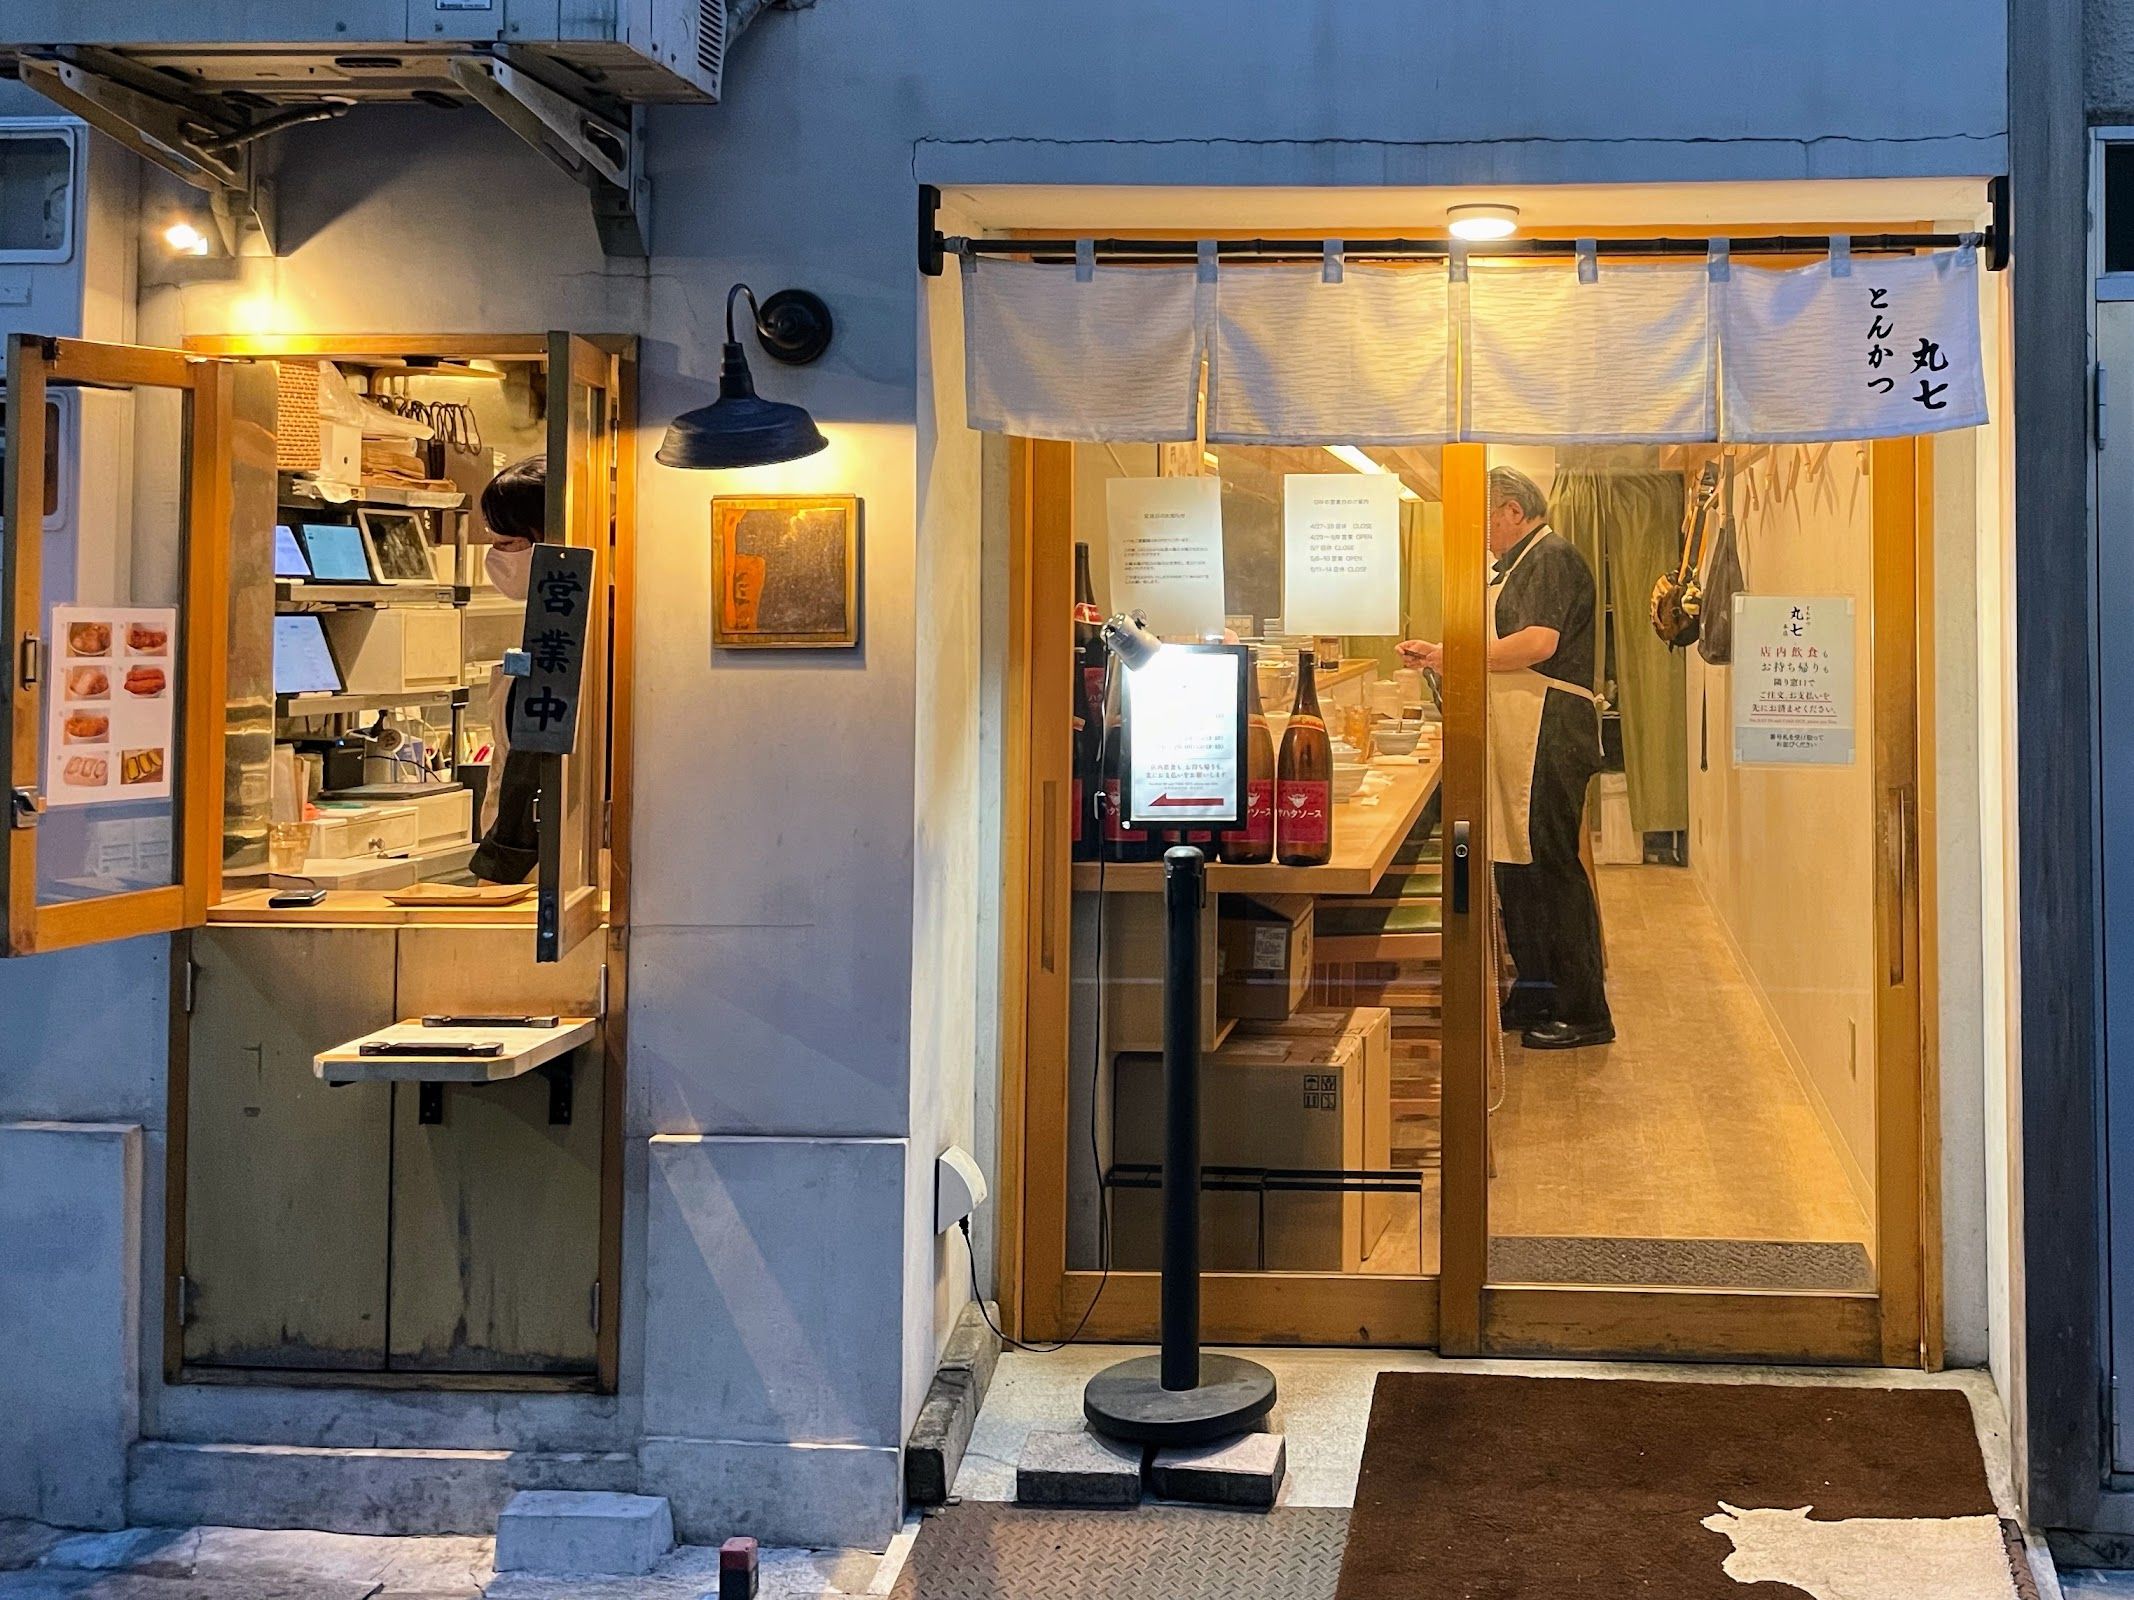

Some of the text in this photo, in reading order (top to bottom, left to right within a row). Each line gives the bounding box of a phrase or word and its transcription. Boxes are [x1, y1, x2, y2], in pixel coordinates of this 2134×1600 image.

[1867, 288, 1895, 394] とんかつ
[1910, 337, 1949, 410] 丸七
[1790, 606, 1804, 637] 丸七
[523, 570, 584, 732] 営業中
[1760, 646, 1829, 658] 店内飲食も
[1761, 661, 1829, 674] お持ち帰りも
[1773, 678, 1816, 687] 隣り窓口で
[1248, 808, 1272, 818] ソース
